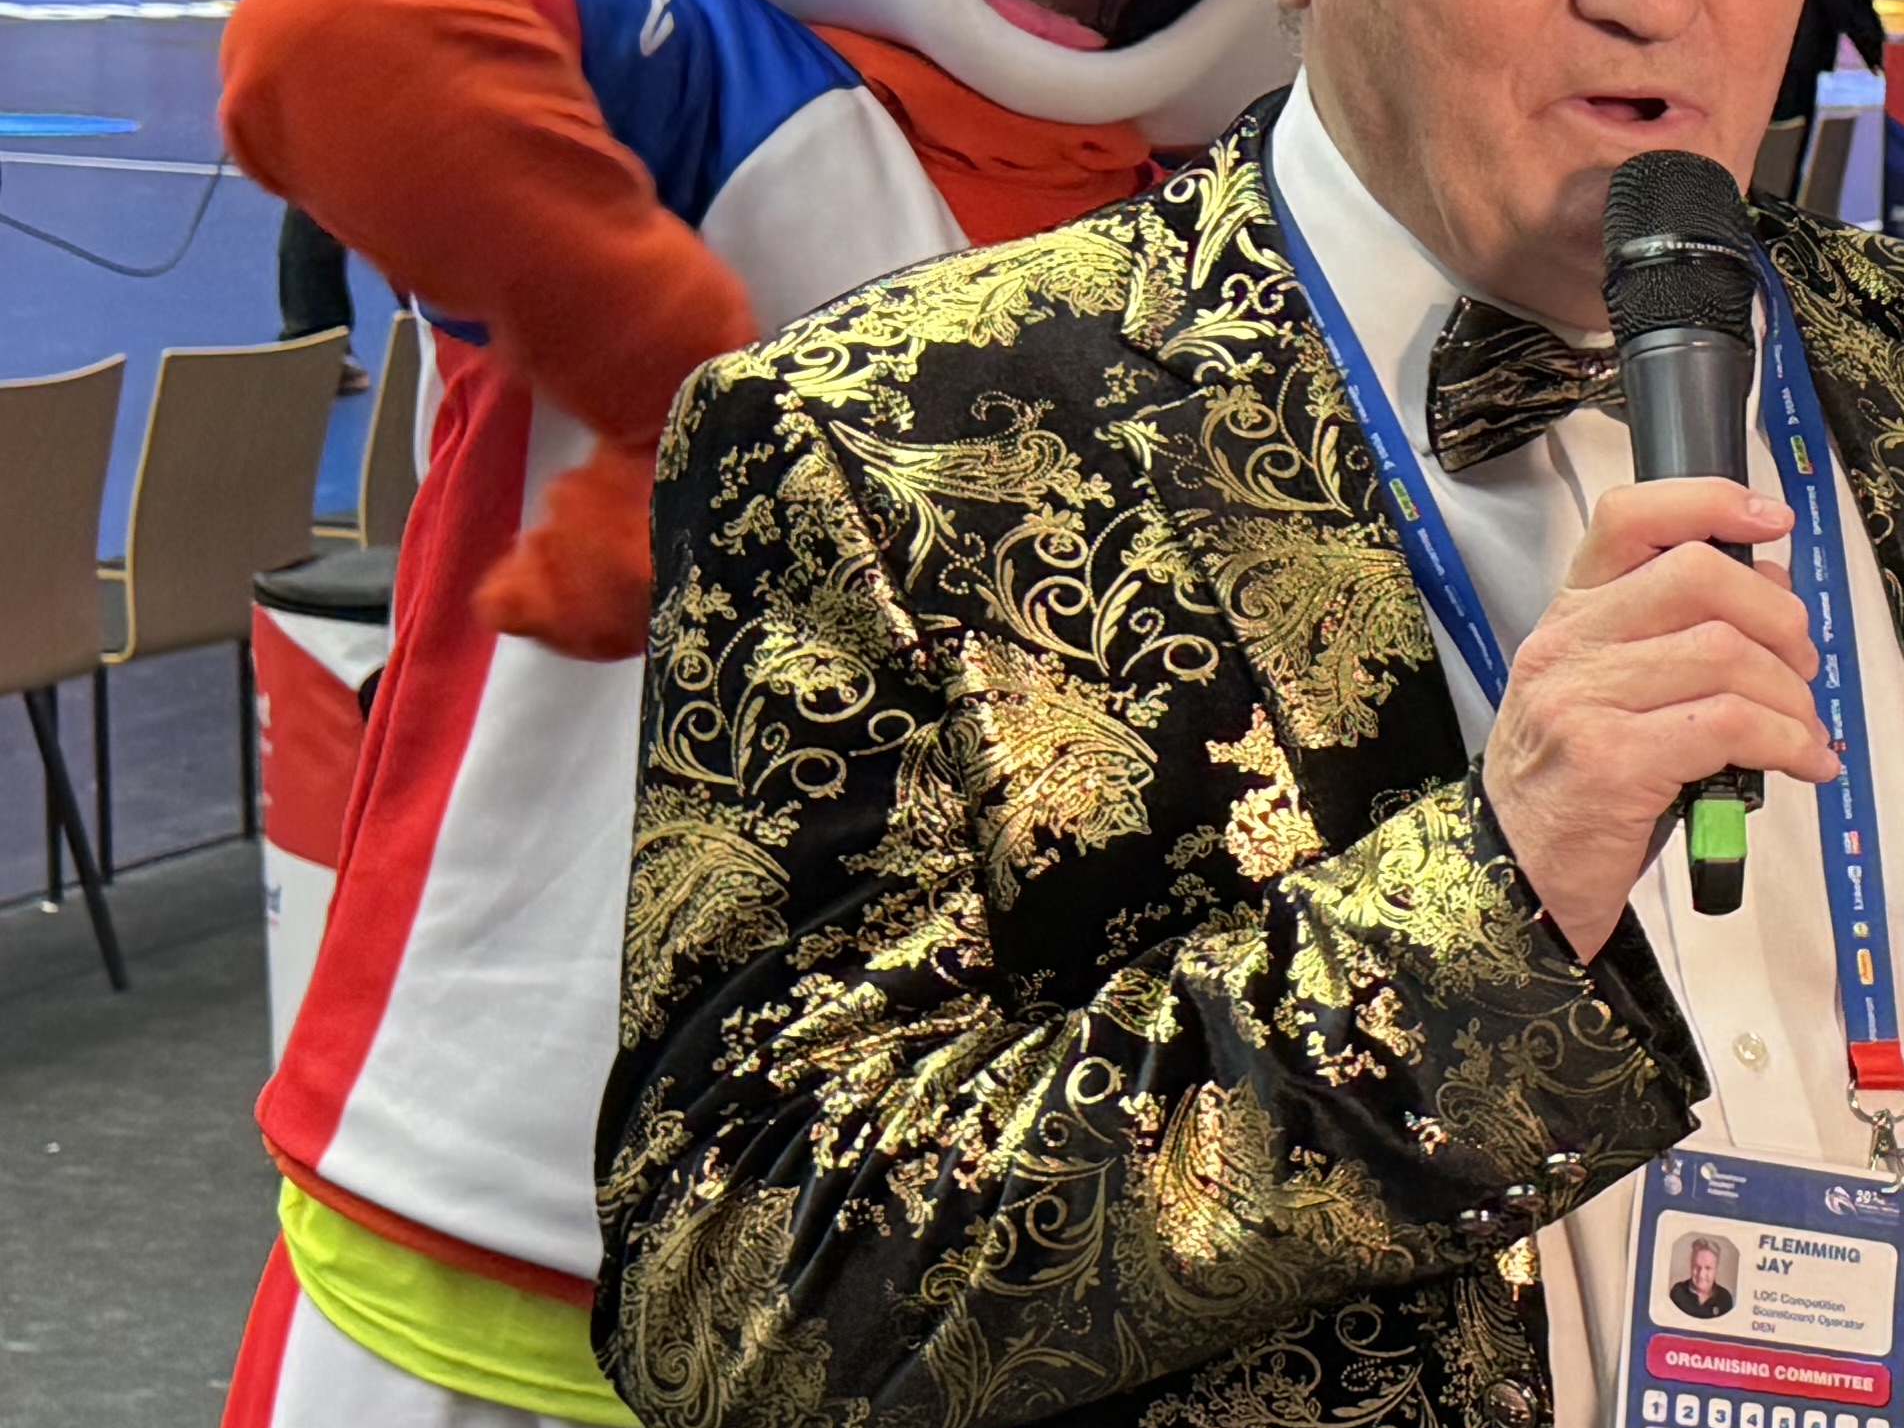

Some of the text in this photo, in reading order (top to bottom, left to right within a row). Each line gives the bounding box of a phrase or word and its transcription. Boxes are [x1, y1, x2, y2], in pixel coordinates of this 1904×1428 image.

[1757, 1234, 1861, 1264] FLEMMING
[1755, 1258, 1794, 1276] JAY
[1664, 1349, 1875, 1393] ORGANISING COMMITTEE
